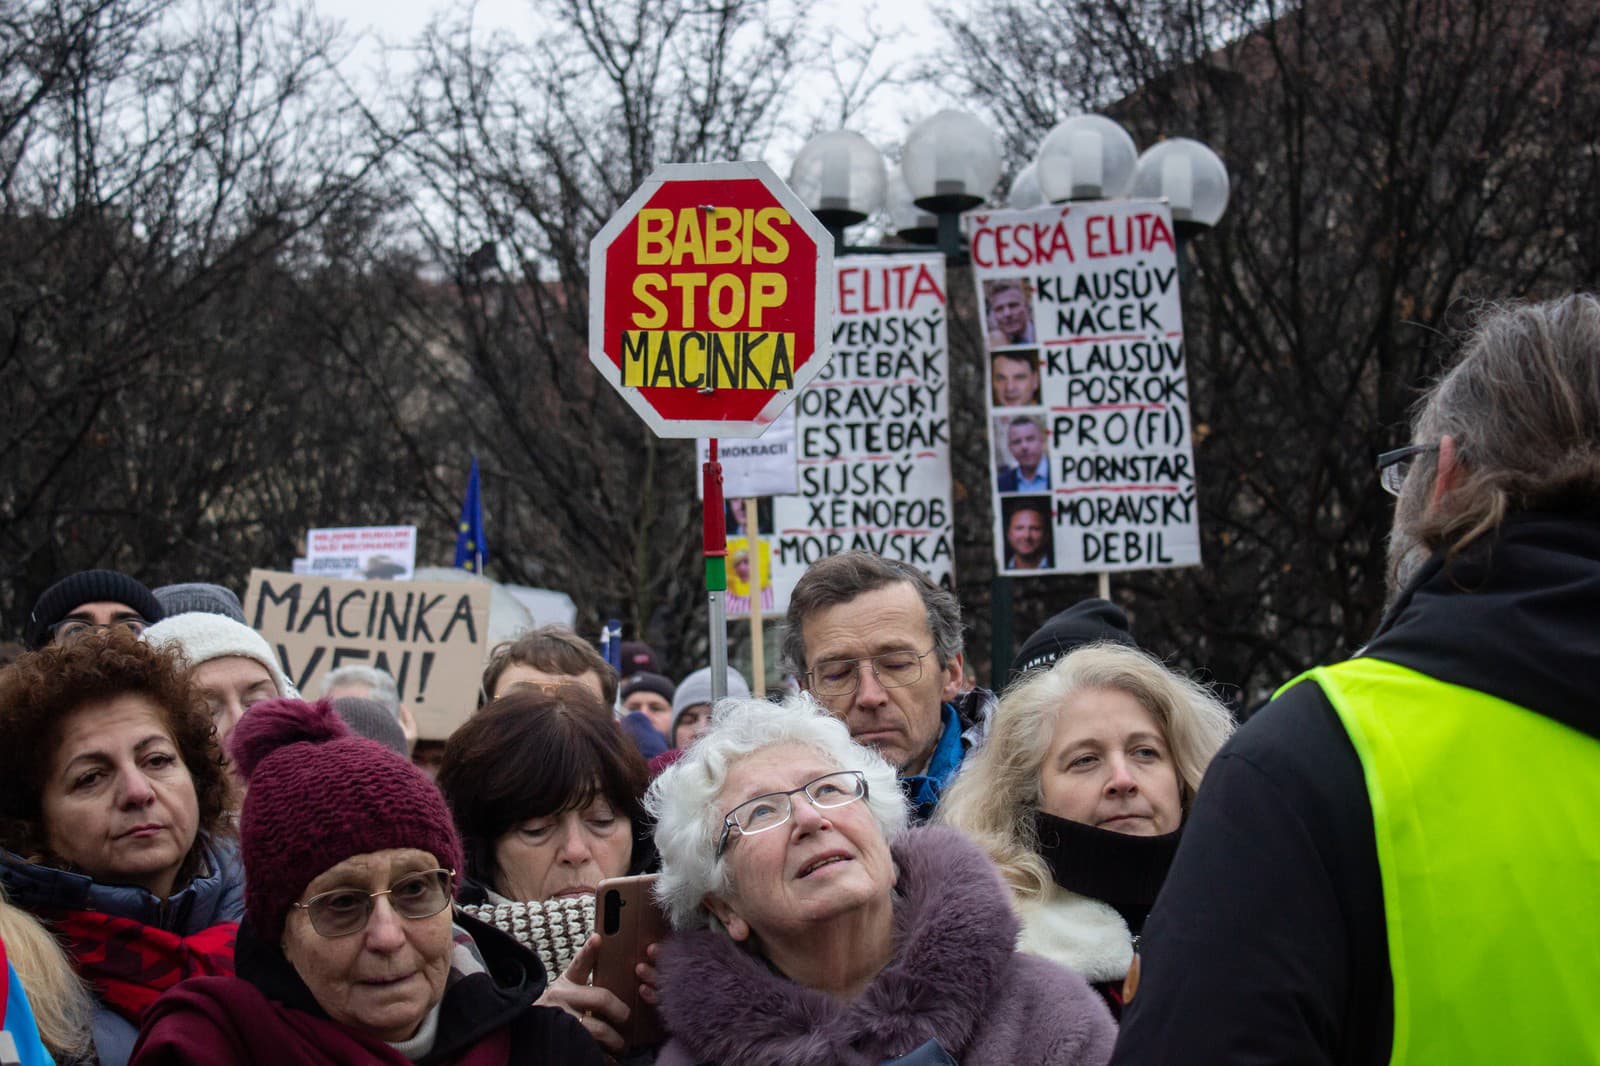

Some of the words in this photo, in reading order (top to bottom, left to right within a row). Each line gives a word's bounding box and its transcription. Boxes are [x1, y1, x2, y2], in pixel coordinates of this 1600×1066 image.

[637, 206, 792, 266] BABIS
[972, 208, 1074, 268] ČESKÁ
[1086, 213, 1176, 259] ELITA
[631, 272, 788, 328] STOP
[838, 263, 945, 315] ELITA
[621, 331, 794, 390] MACINKA
[1068, 375, 1186, 407] POSKOK
[704, 443, 788, 459] MOKRACII
[1062, 455, 1194, 483] PORNSTAR
[808, 500, 946, 528] XENOFOB
[1057, 485, 1195, 526] MORAVSKÝ
[1083, 532, 1173, 563] DEBIL
[253, 580, 477, 643] MACINKA
